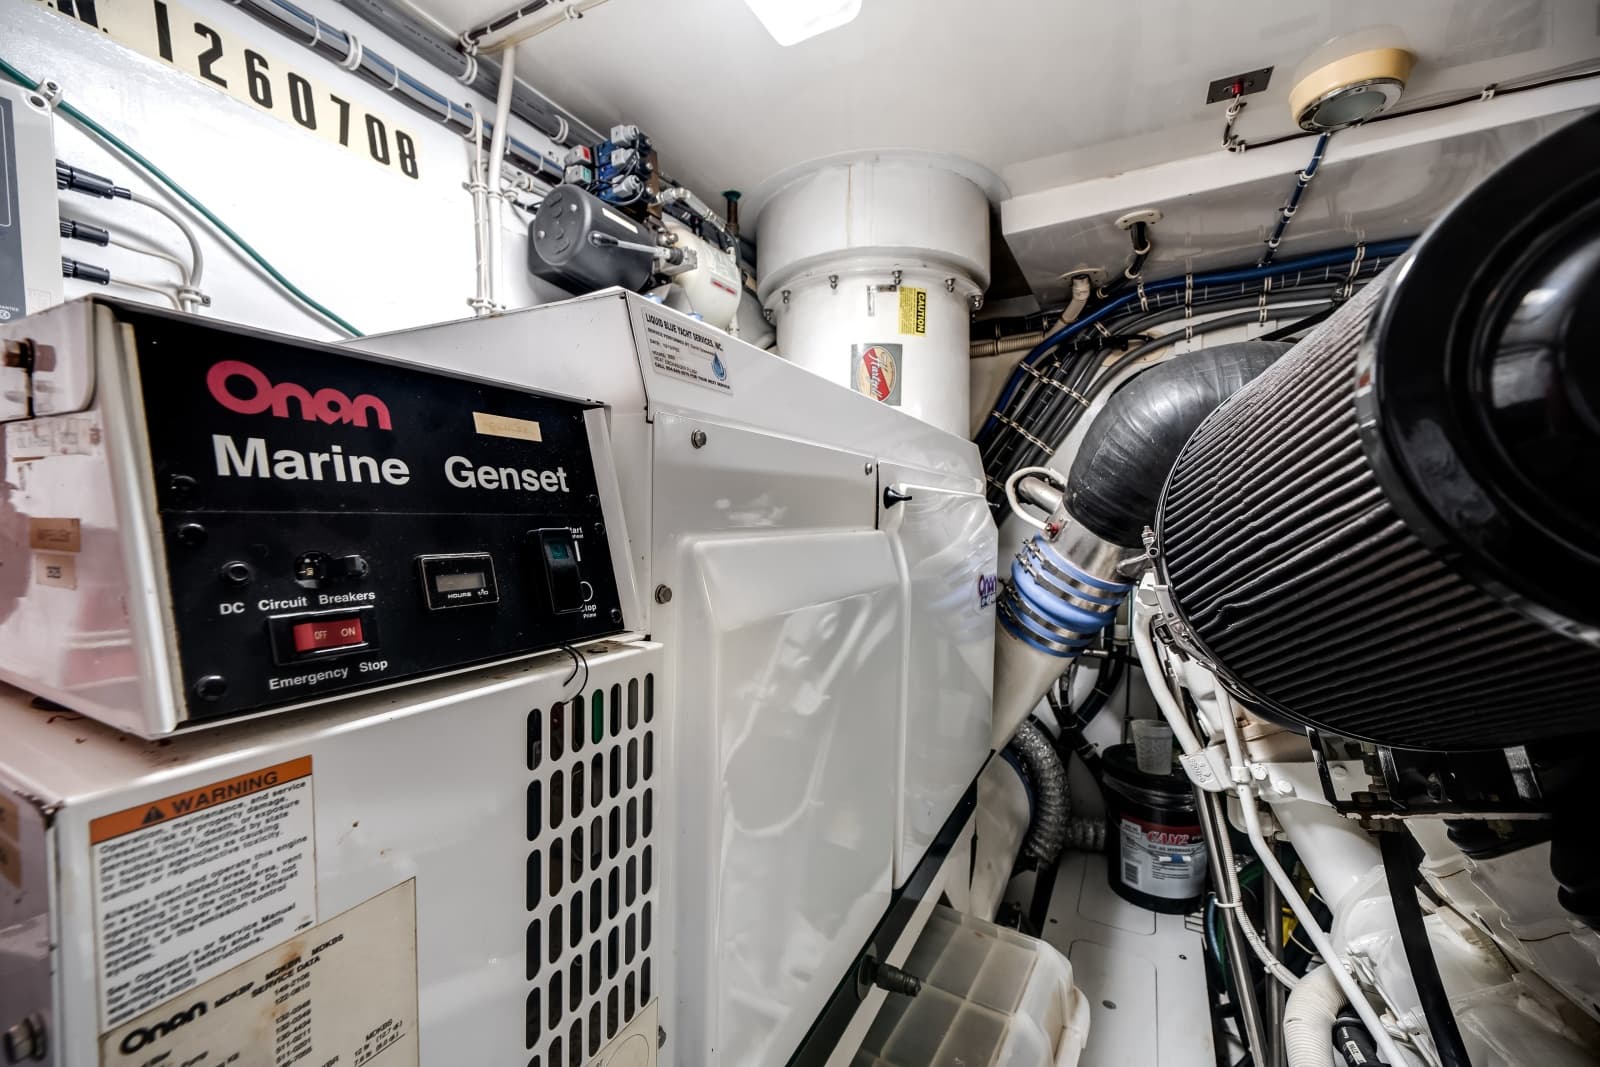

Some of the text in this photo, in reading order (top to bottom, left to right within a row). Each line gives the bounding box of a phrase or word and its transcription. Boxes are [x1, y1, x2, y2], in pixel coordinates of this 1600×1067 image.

[645, 312, 664, 328] LIQUID
[663, 320, 677, 333] BLUE
[676, 326, 692, 339] YACHT
[206, 360, 393, 431] Onan
[211, 433, 570, 493] Marine Genset
[219, 591, 376, 615] DC Circuit Breakers
[314, 626, 356, 640] OFF ON
[269, 659, 389, 691] Emergency Stop
[171, 771, 279, 814] WARNING
[271, 781, 306, 797] service
[100, 848, 157, 874] personal
[254, 799, 300, 819] exposure
[100, 841, 149, 865] present
[153, 833, 176, 845] risk
[196, 811, 243, 832] property
[118, 846, 190, 877] substances
[194, 825, 246, 849] identified
[265, 811, 289, 824] state
[119, 864, 164, 885] federal
[167, 844, 219, 868] agencies
[239, 822, 279, 842] causing
[102, 881, 145, 902] cancer
[167, 846, 239, 877] reproductive
[103, 898, 149, 921] Always
[154, 884, 182, 901] start
[210, 858, 251, 878] operate
[254, 849, 273, 861] this
[276, 835, 308, 852] engine
[103, 910, 165, 940] operating
[202, 873, 251, 899] enclosed
[282, 852, 302, 866] vent
[132, 903, 157, 919] well
[162, 877, 219, 906] ventilated
[104, 936, 149, 959] modify
[170, 908, 211, 930] tamper
[214, 897, 237, 911] with
[259, 870, 298, 892] exhaust
[129, 912, 179, 939] exhaust
[198, 901, 248, 927] emission
[250, 883, 287, 904] control
[218, 921, 258, 944] Service
[261, 902, 296, 924] Manual
[129, 961, 190, 995] important
[193, 944, 227, 964] safety
[253, 917, 284, 936] health
[251, 956, 321, 998] SERVICE DATA
[107, 982, 166, 1015] warnings
[119, 1001, 208, 1056] Onan
